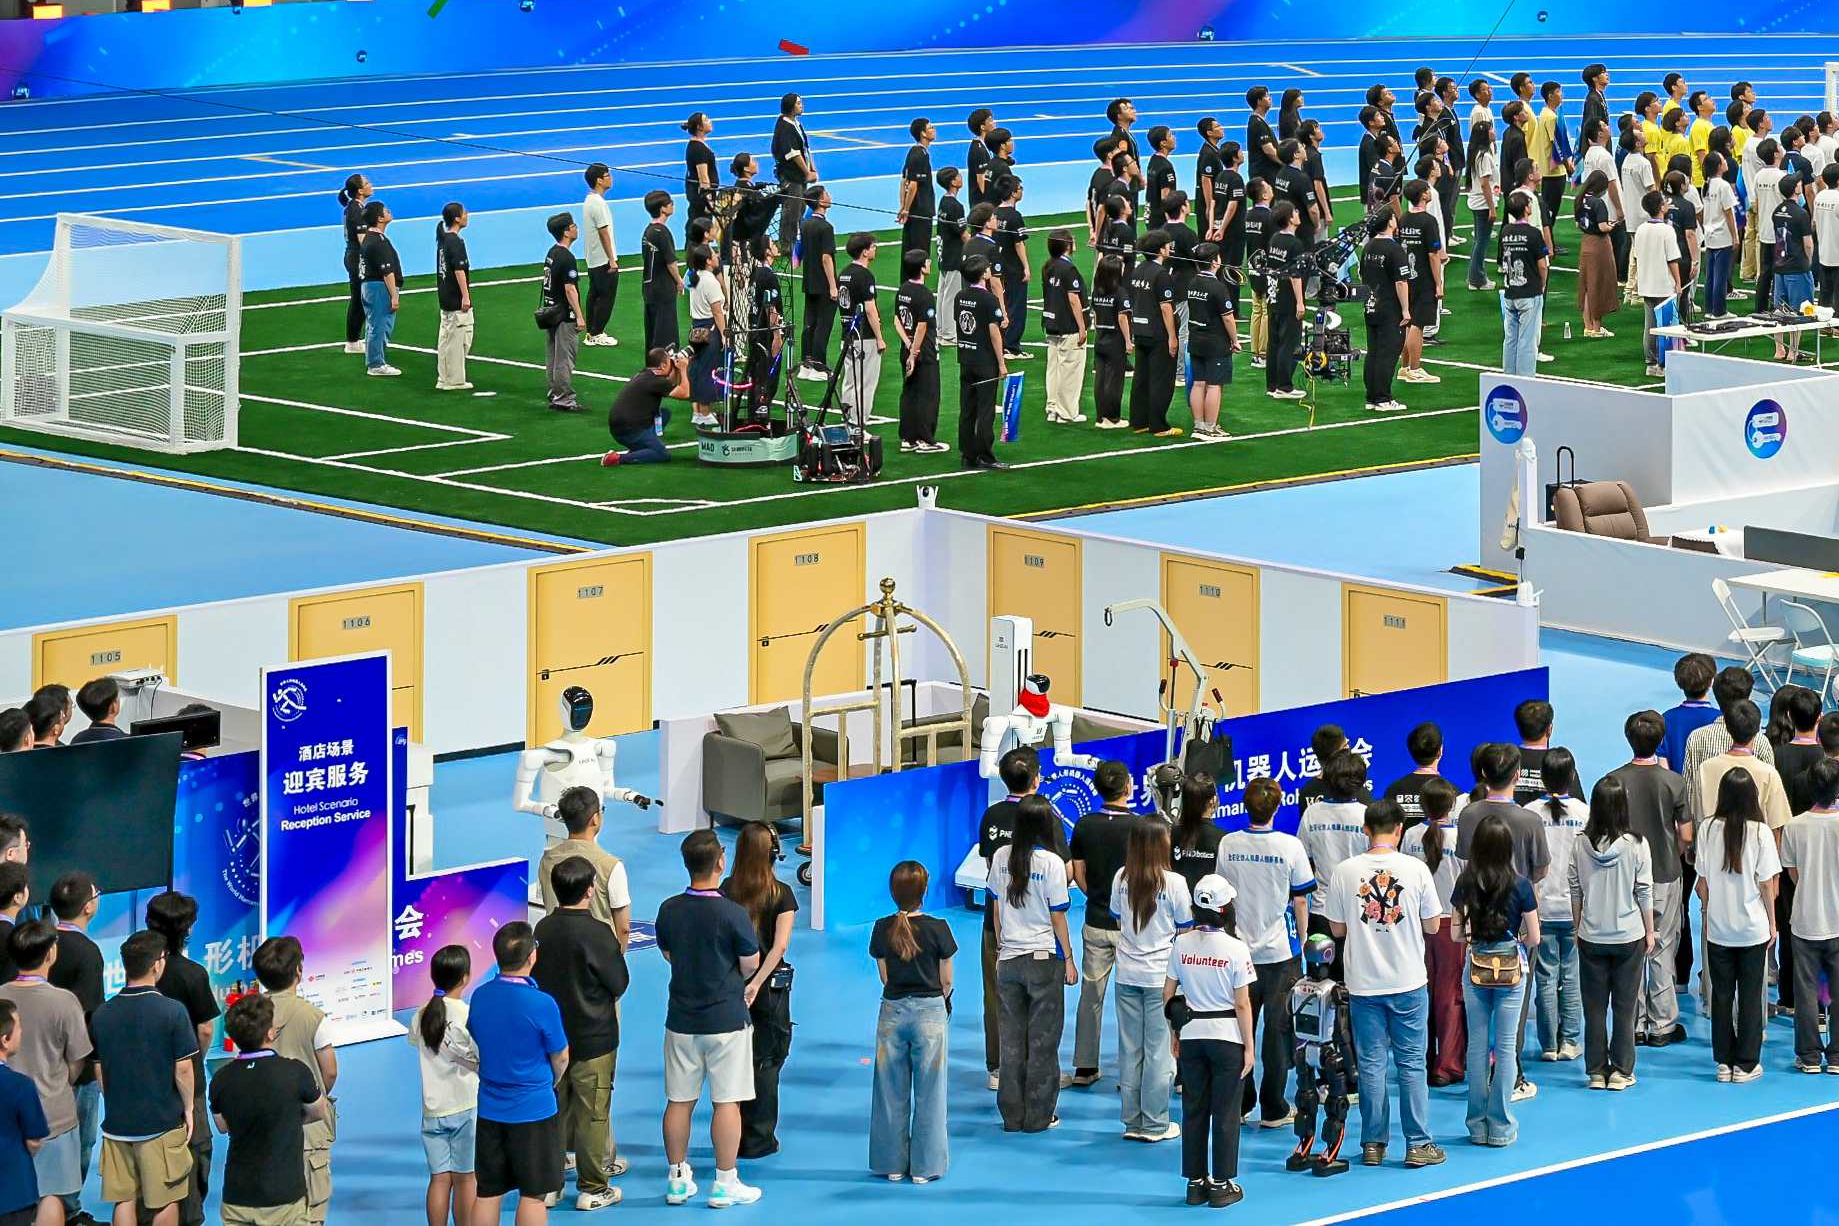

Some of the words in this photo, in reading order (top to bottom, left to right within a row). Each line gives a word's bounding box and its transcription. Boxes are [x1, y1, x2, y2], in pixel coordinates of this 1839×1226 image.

[795, 554, 819, 565] 1108
[1024, 555, 1045, 567] 1109
[578, 586, 604, 599] 1107
[1200, 586, 1221, 597] 1110
[344, 617, 371, 629] 1106
[1384, 616, 1406, 628] 1111
[91, 651, 121, 664] 1105
[299, 739, 354, 762] 酒店场景
[283, 761, 369, 795] 迎宾服务
[294, 802, 318, 815] Hotel
[319, 797, 359, 811] Scenario
[281, 814, 332, 831] Reception
[334, 809, 371, 823] Service
[1181, 954, 1229, 969] Volunteer
